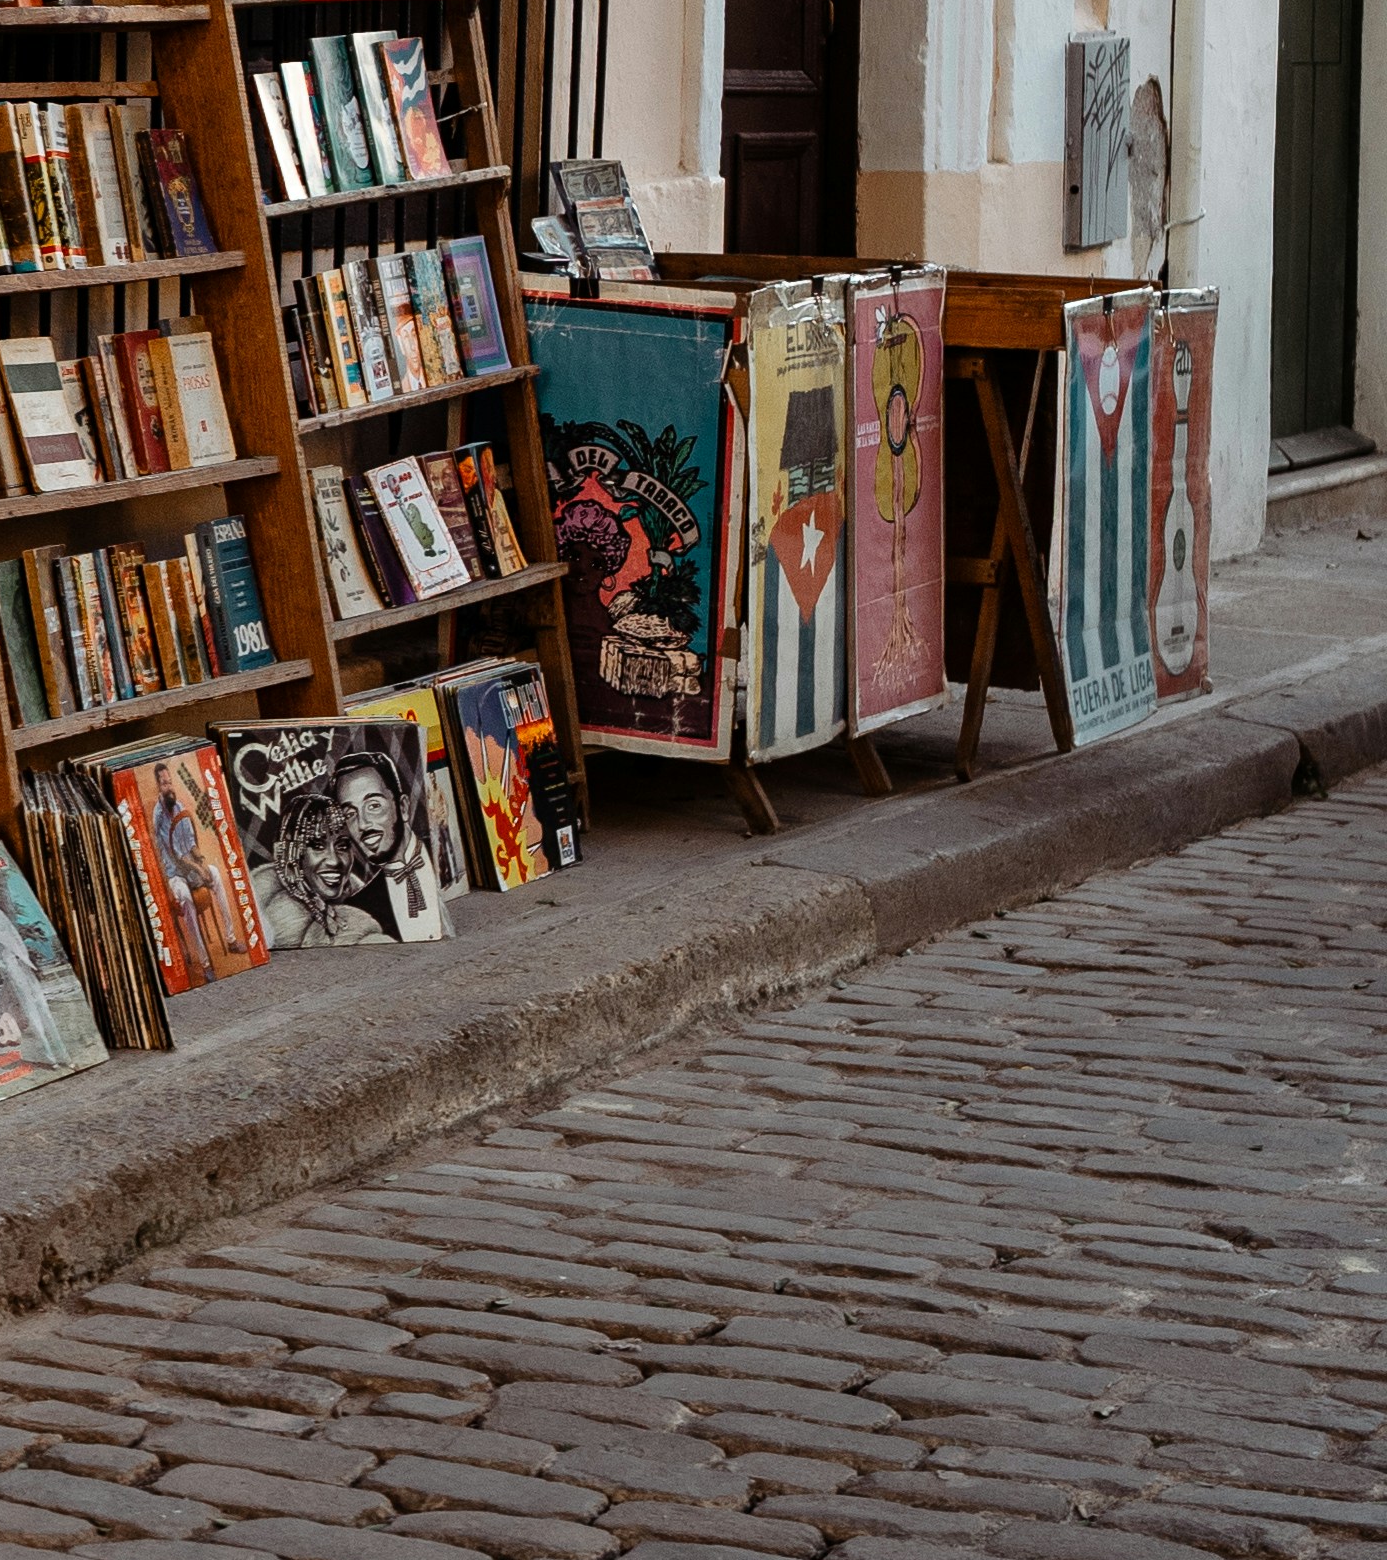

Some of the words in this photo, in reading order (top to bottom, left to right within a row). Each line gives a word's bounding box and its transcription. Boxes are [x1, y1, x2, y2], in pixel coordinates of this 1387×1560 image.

[573, 448, 611, 473] DEL
[634, 472, 695, 537] TABACO
[233, 621, 270, 657] 1981
[1073, 678, 1109, 717] FUERA
[1112, 668, 1128, 700] DE
[1130, 656, 1154, 692] LIGA
[232, 733, 318, 794] Celia
[239, 756, 329, 821] Willie
